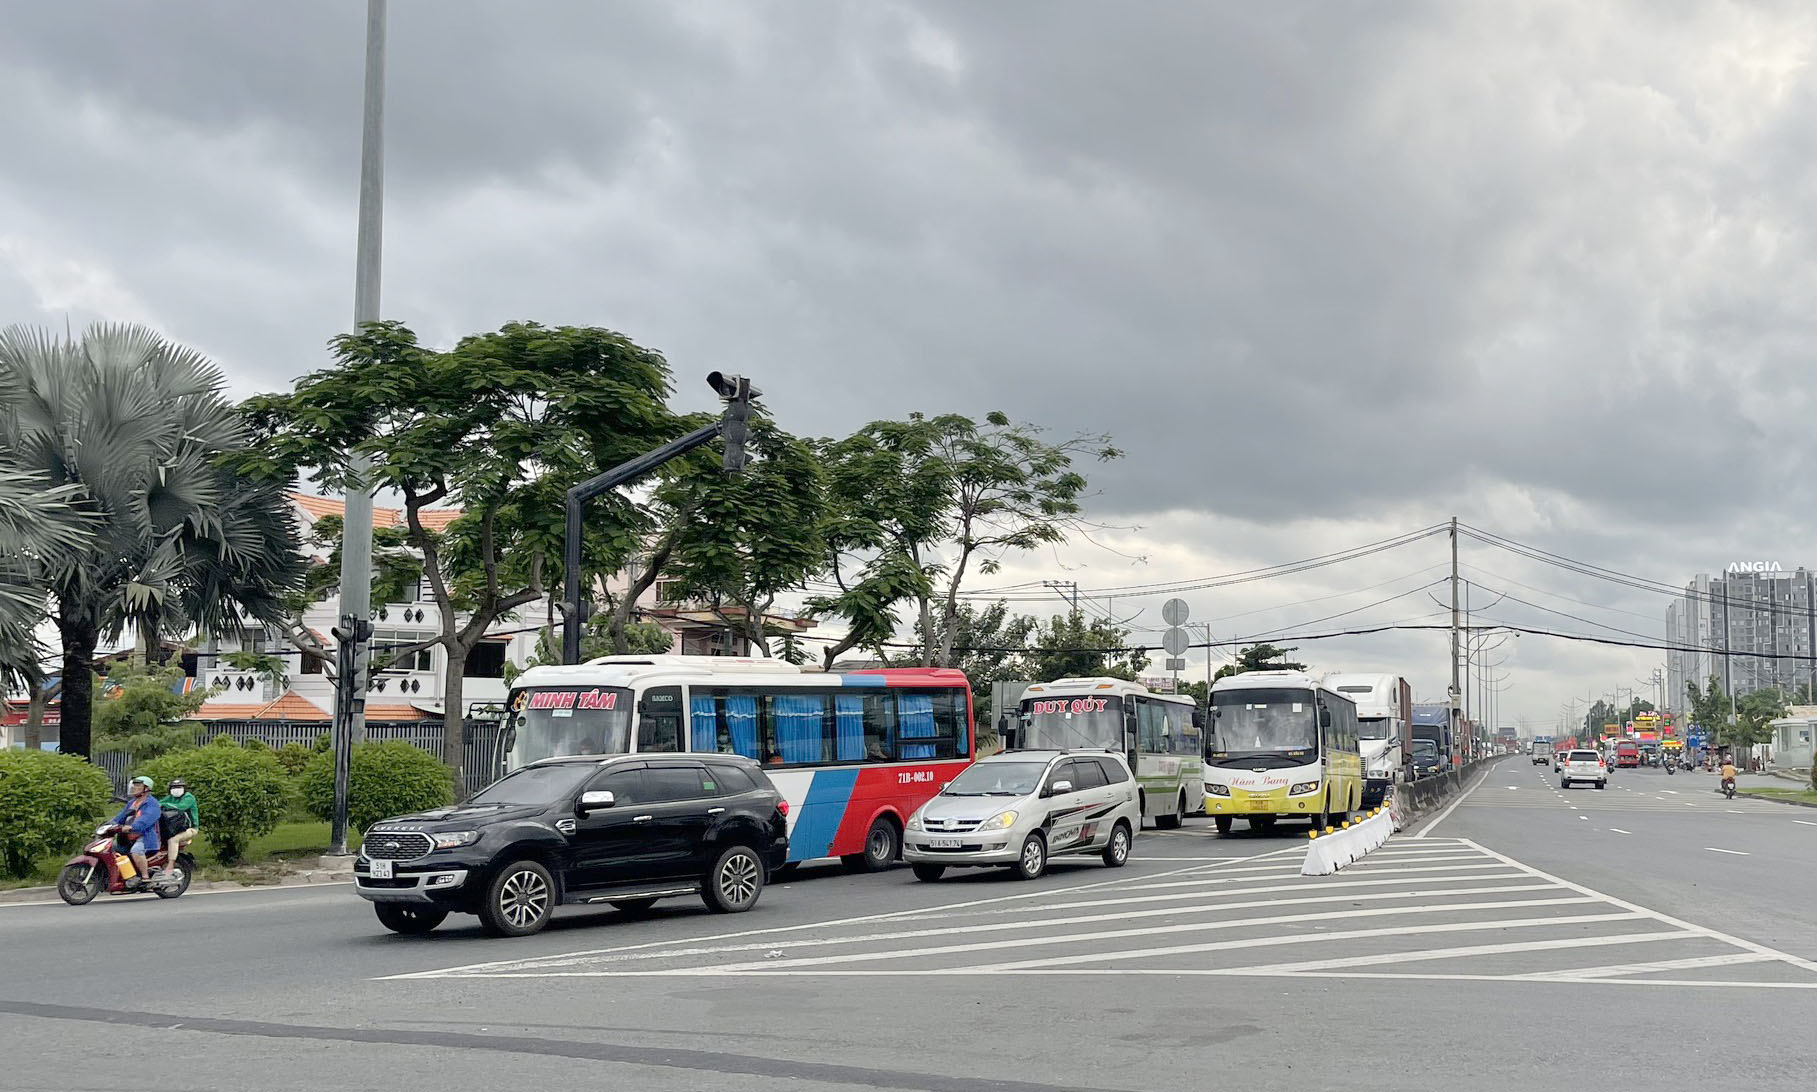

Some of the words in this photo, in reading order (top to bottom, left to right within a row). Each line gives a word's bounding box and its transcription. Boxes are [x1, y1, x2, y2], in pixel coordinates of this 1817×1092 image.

[1728, 561, 1782, 572] ANGIA
[528, 692, 577, 709] MINH
[577, 688, 617, 710] TÂM
[1033, 700, 1069, 714] DUY
